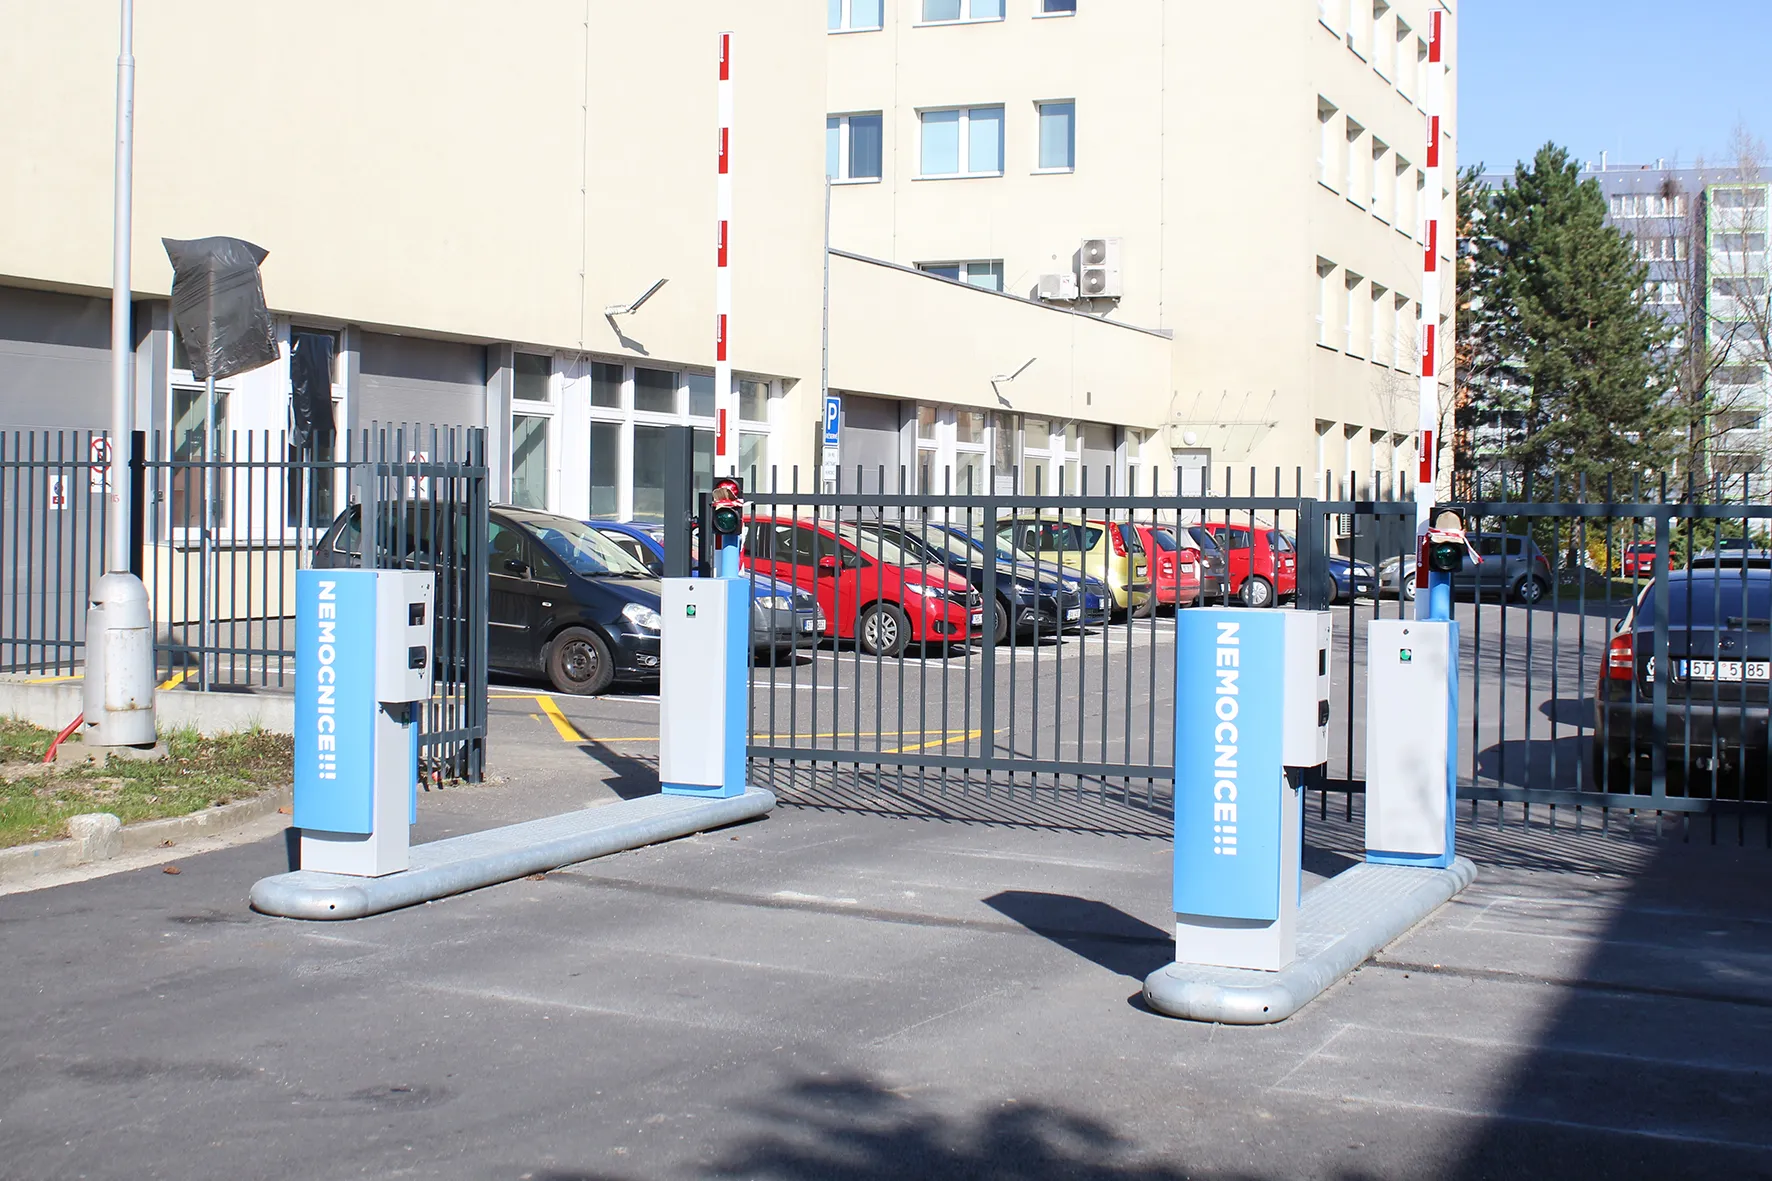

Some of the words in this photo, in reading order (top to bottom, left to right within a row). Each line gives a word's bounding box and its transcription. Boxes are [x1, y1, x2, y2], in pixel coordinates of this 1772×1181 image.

[828, 402, 838, 430] P
[317, 580, 337, 780] NEMOCNICE!!!
[1730, 663, 1764, 677] 585
[1213, 621, 1240, 856] NEMOCNICE!!!
